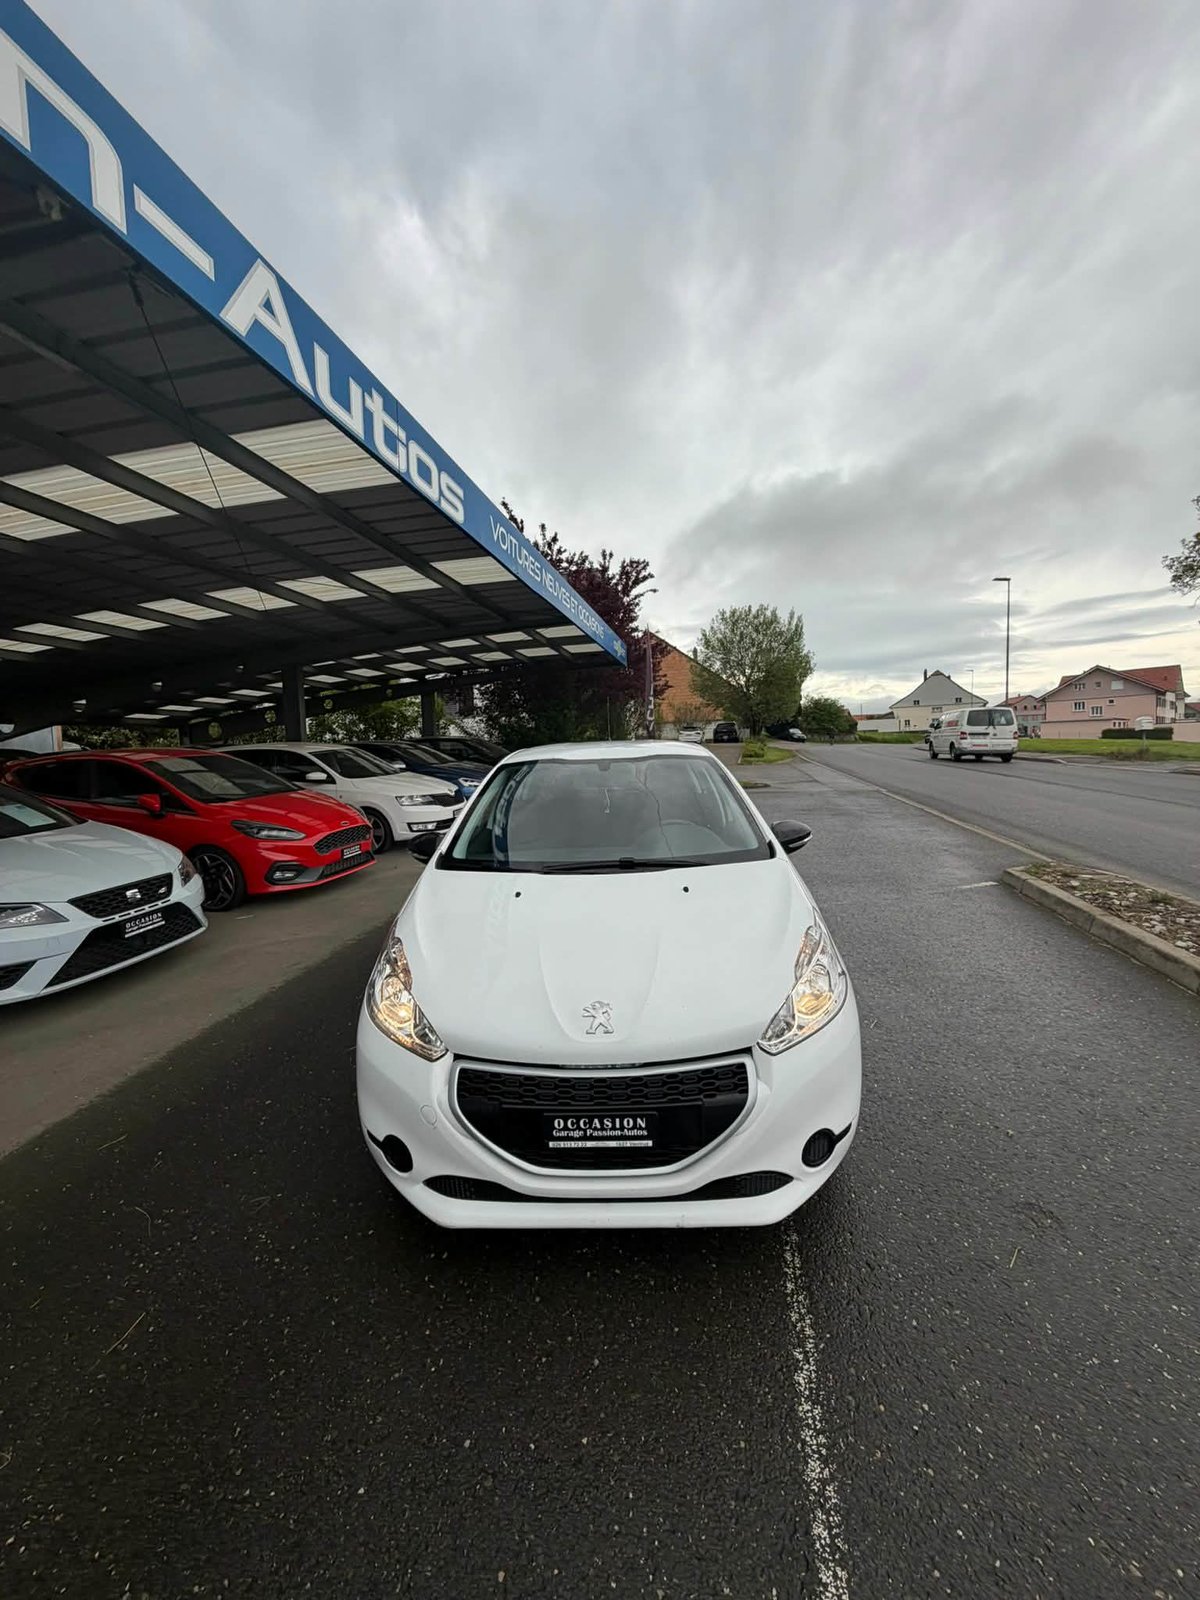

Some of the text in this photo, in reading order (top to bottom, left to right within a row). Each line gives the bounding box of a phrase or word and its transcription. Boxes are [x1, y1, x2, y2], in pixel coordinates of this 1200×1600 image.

[490, 515, 541, 582] VOITURES
[542, 568, 570, 608] NEUVES
[570, 595, 579, 615] ET
[553, 1117, 646, 1129] OCCASION
[552, 1128, 648, 1138] Garage Passion-Autos
